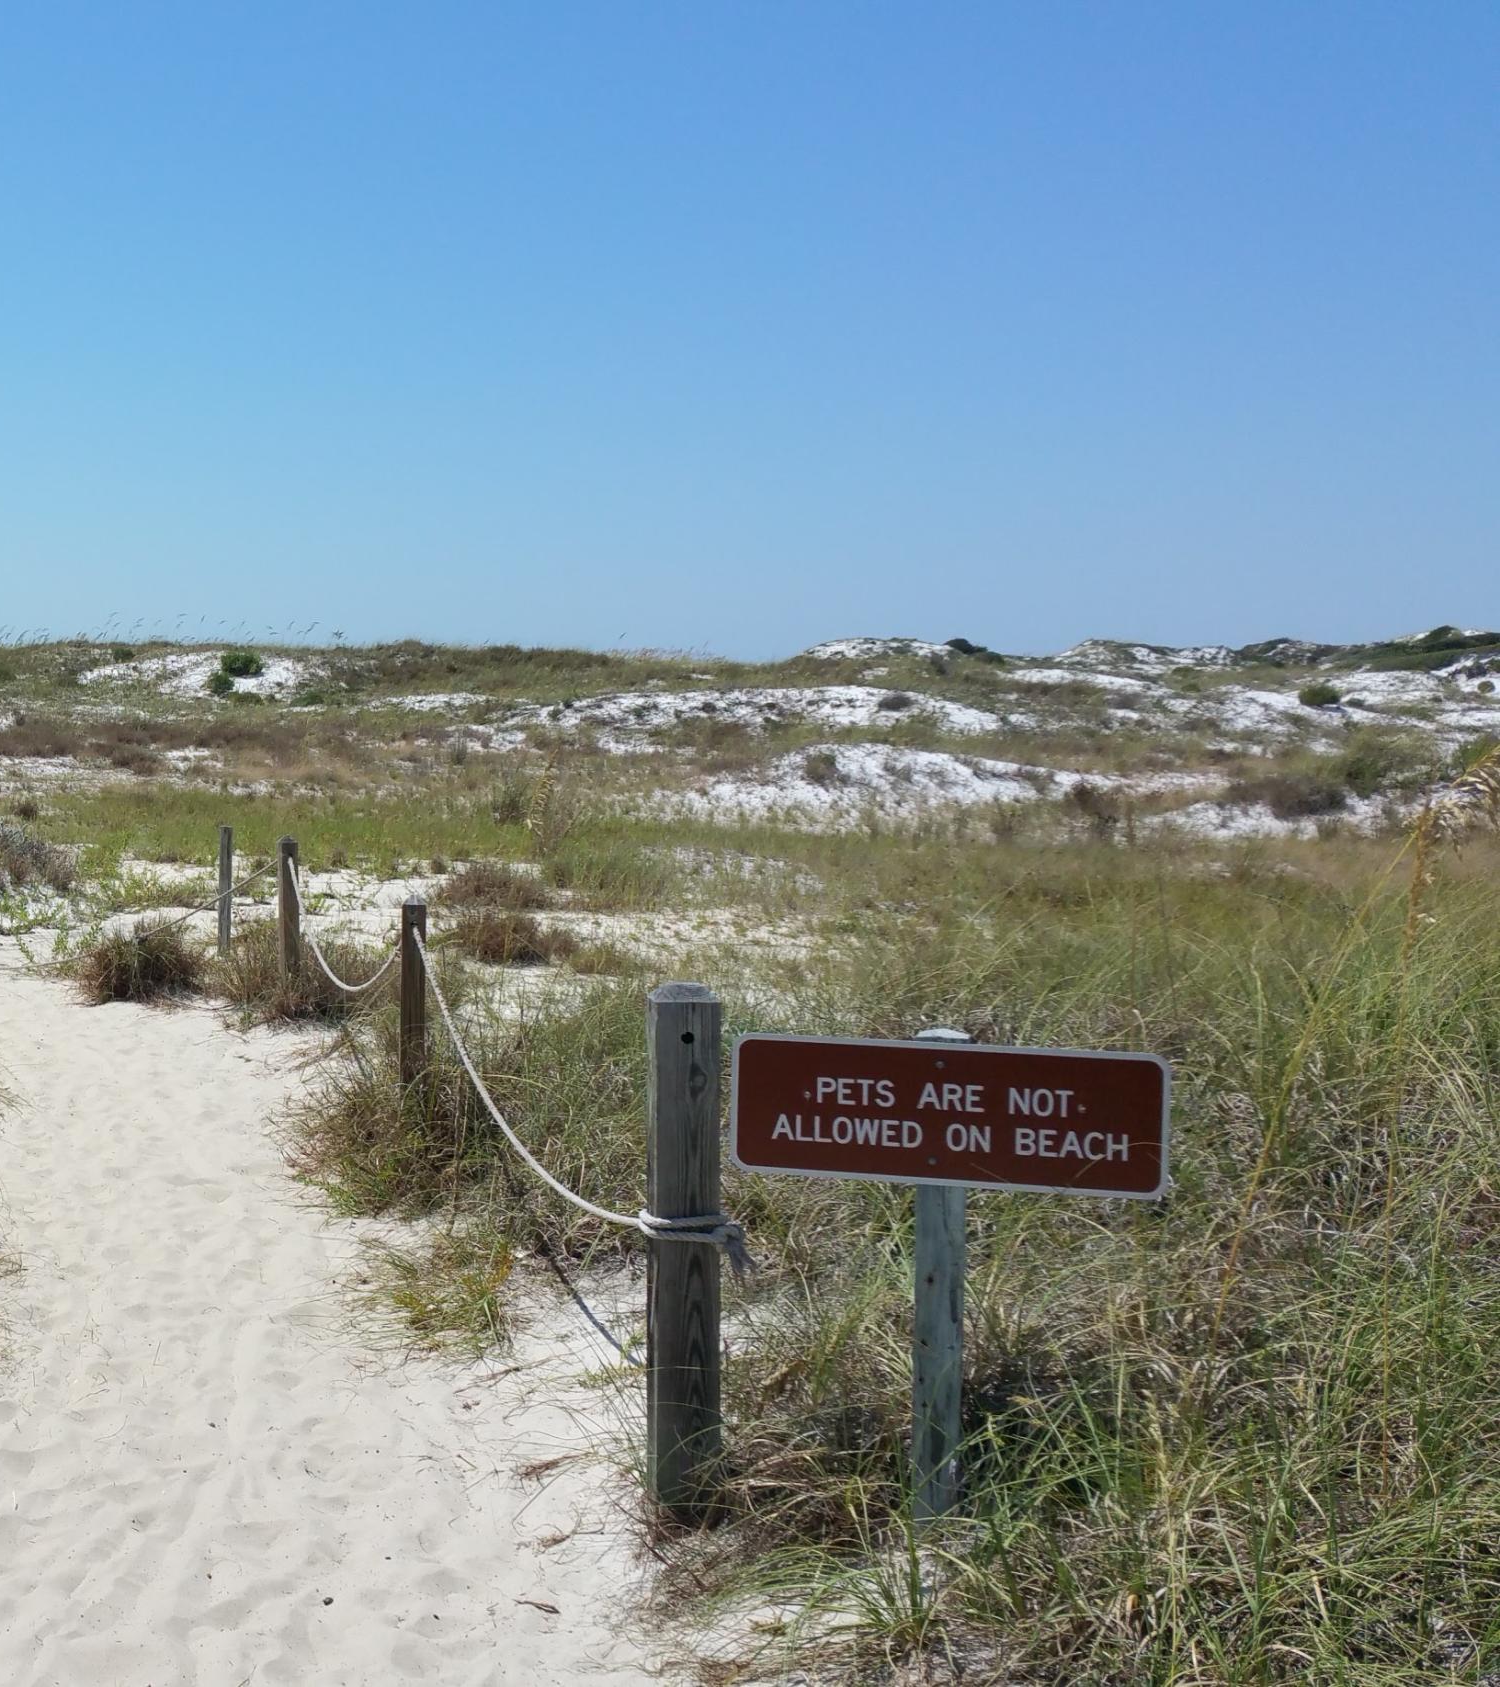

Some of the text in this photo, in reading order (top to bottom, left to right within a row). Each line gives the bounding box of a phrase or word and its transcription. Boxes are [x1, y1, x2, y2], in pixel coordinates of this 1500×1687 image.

[815, 1077, 1074, 1118] PETS ARE NOT
[771, 1114, 1129, 1162] ALLOWED ON BEACH
